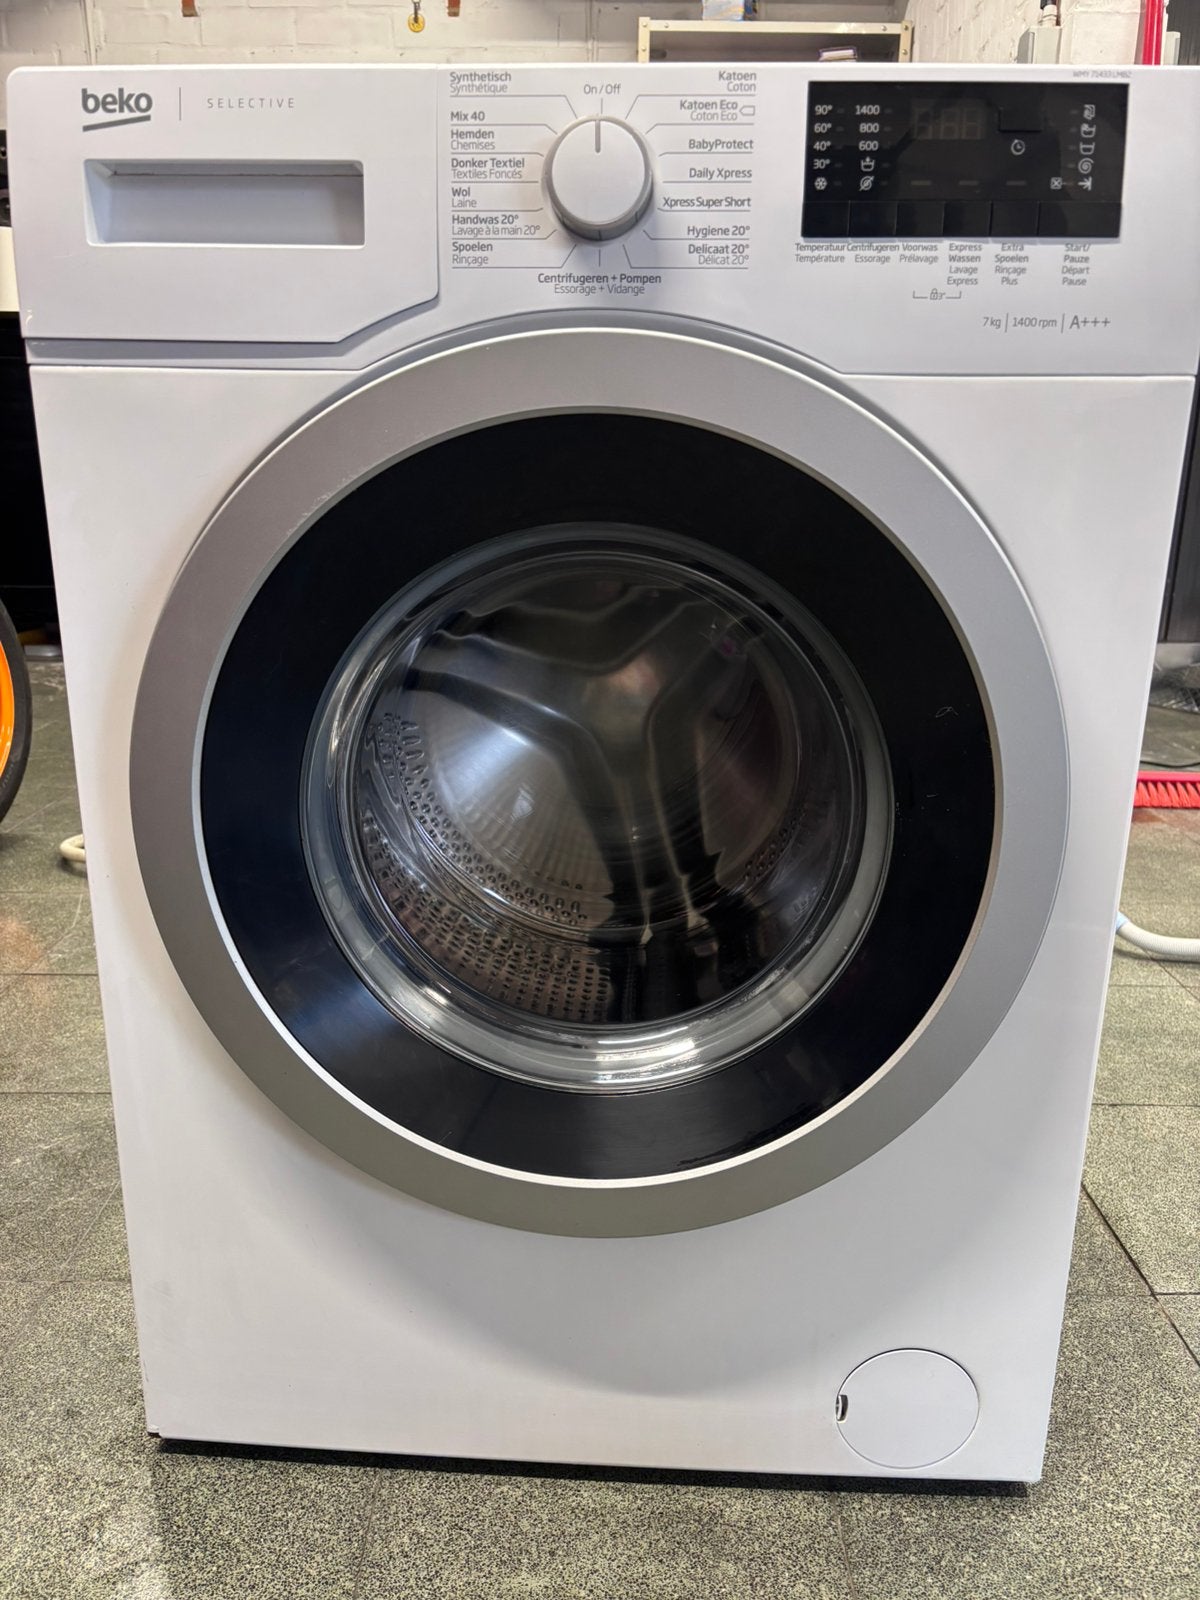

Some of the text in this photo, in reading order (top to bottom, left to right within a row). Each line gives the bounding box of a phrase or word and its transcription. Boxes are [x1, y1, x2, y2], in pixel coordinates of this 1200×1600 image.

[450, 72, 512, 84] Synthetisch
[718, 70, 757, 80] Katoen
[450, 82, 508, 96] Synthétique
[727, 82, 756, 92] Coton
[81, 88, 153, 114] beko
[207, 98, 295, 109] SELECTIVE
[680, 100, 738, 110] Katoen Eco
[815, 104, 833, 115] 90°
[855, 104, 880, 115] 1400
[451, 111, 485, 121] Mix 40
[690, 110, 738, 120] Coton Eco
[814, 122, 832, 133] 60°
[859, 122, 880, 133] 800
[451, 129, 494, 139] Hemden
[451, 140, 496, 150] Chemises
[688, 139, 754, 151] BabyProtect
[813, 140, 831, 151] 40°
[858, 140, 878, 151] 600
[451, 158, 525, 168] Donker Textiel
[813, 159, 830, 169] 30°
[452, 168, 522, 179] Textiles Foncés
[689, 168, 752, 180] Daily Xpress
[452, 187, 470, 197] Wol
[452, 198, 477, 208] Laine
[663, 196, 751, 208] Xpress Super Short
[452, 214, 519, 224] Handwas 20°
[452, 225, 541, 237] Lavage à la main 20°
[687, 226, 750, 238] Hygiene 20°
[452, 242, 493, 255] Spoelen
[688, 244, 749, 254] Delicaat 20°
[795, 242, 846, 253] Temperatuur
[846, 242, 900, 253] Centrifugeren
[901, 243, 938, 252] Voorwas
[949, 243, 982, 252] Express
[1001, 243, 1024, 251] Extra
[1064, 243, 1091, 252] Start/
[452, 254, 489, 266] Rinçage
[698, 254, 749, 264] Délicat 20°
[795, 254, 845, 264] Température
[854, 254, 890, 264] Essorage
[900, 254, 939, 265] Prélavage
[948, 254, 981, 263] Wassen
[994, 254, 1029, 264] Spoelen
[1064, 254, 1090, 263] Pauze
[949, 265, 978, 275] Lavage
[994, 265, 1027, 276] Rinçage
[1062, 265, 1090, 275] Départ
[538, 272, 609, 284] Centrifugeren
[620, 273, 662, 285] Pompen
[947, 277, 978, 287] Express
[1001, 277, 1018, 286] Plus
[1062, 277, 1087, 286] Pause
[554, 284, 596, 296] Essorage
[607, 284, 645, 296] Vidange
[982, 317, 1001, 329] 7 kg
[1012, 317, 1057, 330] 1400 rpm
[1069, 315, 1111, 329] A+++
